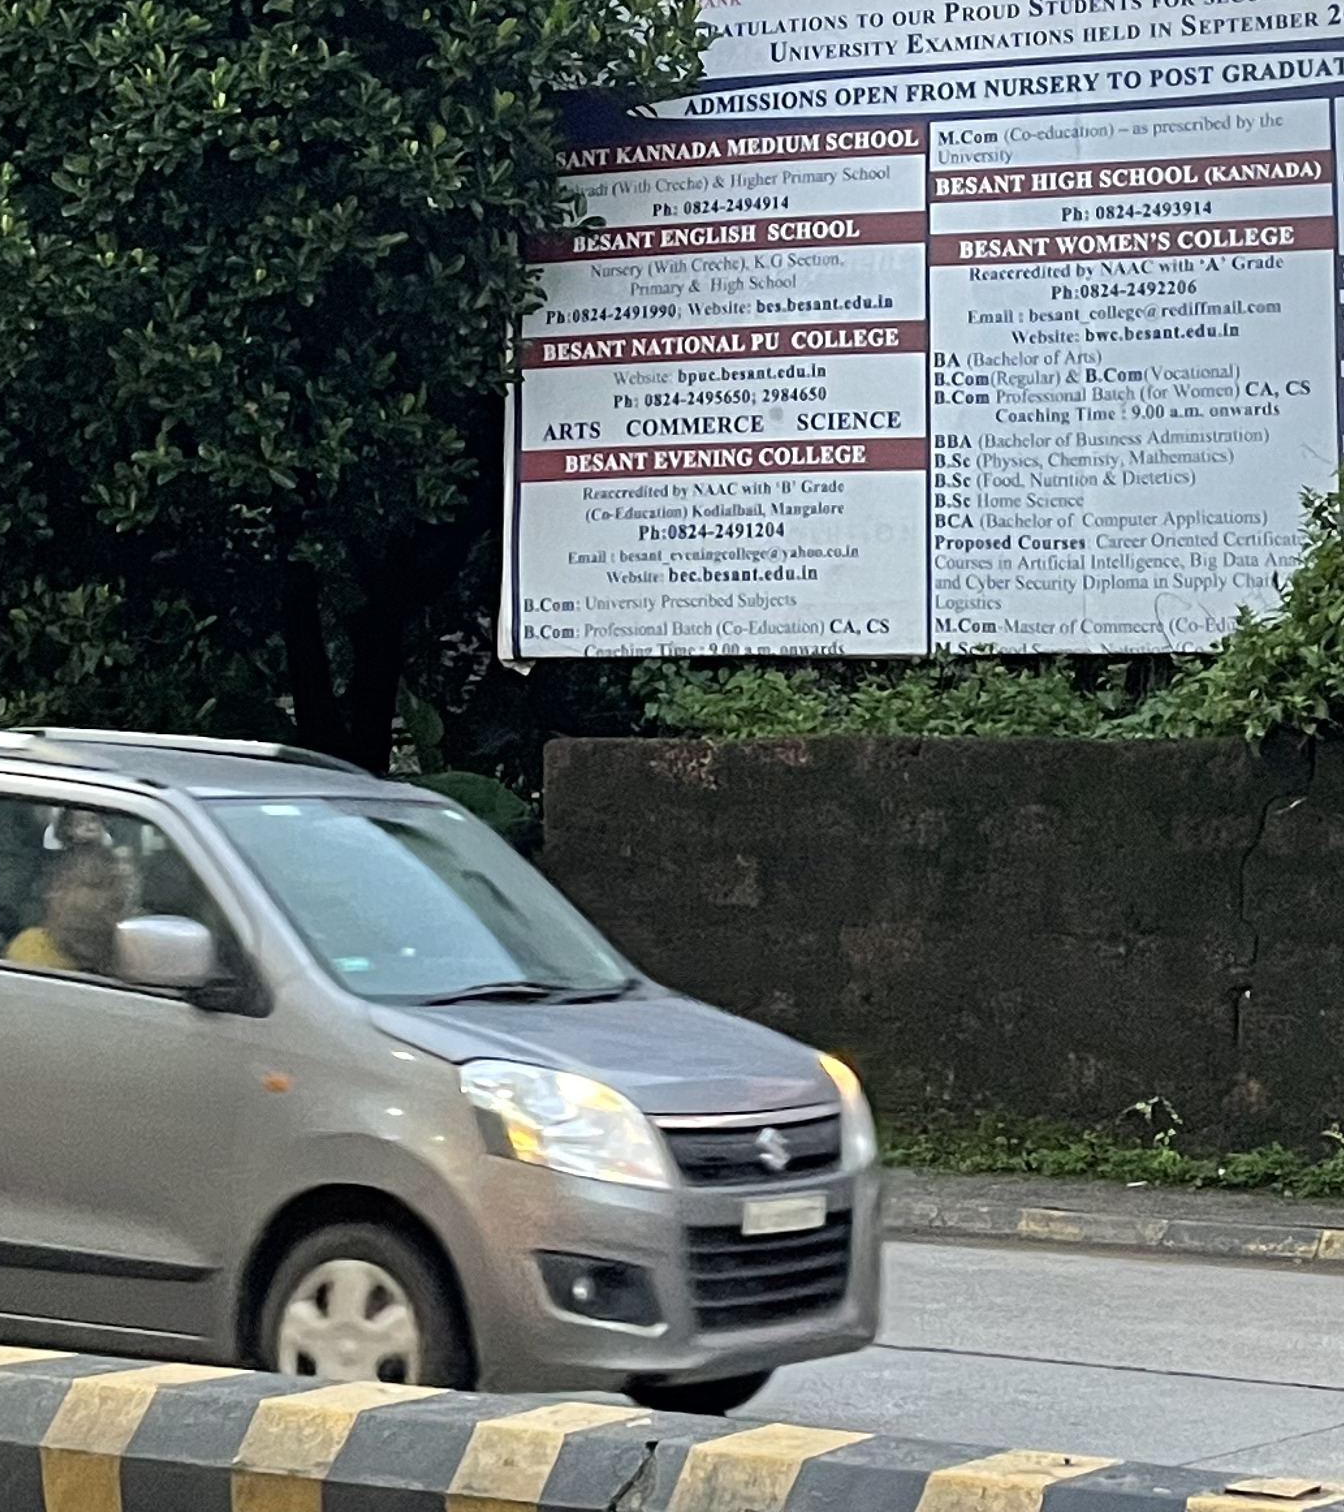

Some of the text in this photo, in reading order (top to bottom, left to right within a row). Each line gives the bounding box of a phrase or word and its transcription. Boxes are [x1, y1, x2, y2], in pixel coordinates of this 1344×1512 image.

[856, 12, 883, 29] TO
[891, 8, 935, 27] OUR
[944, 1, 1020, 24] PROUD
[770, 38, 898, 63] UNIVERSITY
[906, 28, 1075, 55] EXAMINATIONS
[1082, 23, 1140, 43] HELD
[1149, 21, 1172, 39] IN
[1180, 9, 1319, 37] SEPTEMBER
[684, 88, 827, 117] ADMISSIONS
[834, 83, 899, 106] OPEN
[905, 79, 977, 103] FROM
[983, 70, 1100, 101] NURSERY
[1106, 70, 1142, 91] TO
[1149, 65, 1214, 88] POST
[615, 128, 919, 164] KANNADA MEDIUM SCHOOL
[935, 160, 1322, 196] BESANT HIGH SCHOOL (KANNADA)
[683, 195, 789, 215] 0824-2494914
[1061, 200, 1213, 222] Ph: 0824-2493914
[573, 218, 860, 254] BESANT ENGLISH SCHOOL
[959, 225, 1295, 259] BESANT WOMEN’S COLLEGE
[1051, 280, 1197, 301] Ph:0824-2492206
[543, 328, 900, 362] BESANT NATIONAL PU COLLEGE
[761, 386, 827, 404] 2984650
[543, 410, 901, 442] ARTS COMMERCE SCIENCE
[564, 444, 867, 473] BESANT EVENING COLLEGE
[638, 522, 785, 541] Ph:0824-2491204
[934, 535, 1012, 552] Proposed
[672, 620, 713, 636] Batch
[866, 618, 890, 634] CS
